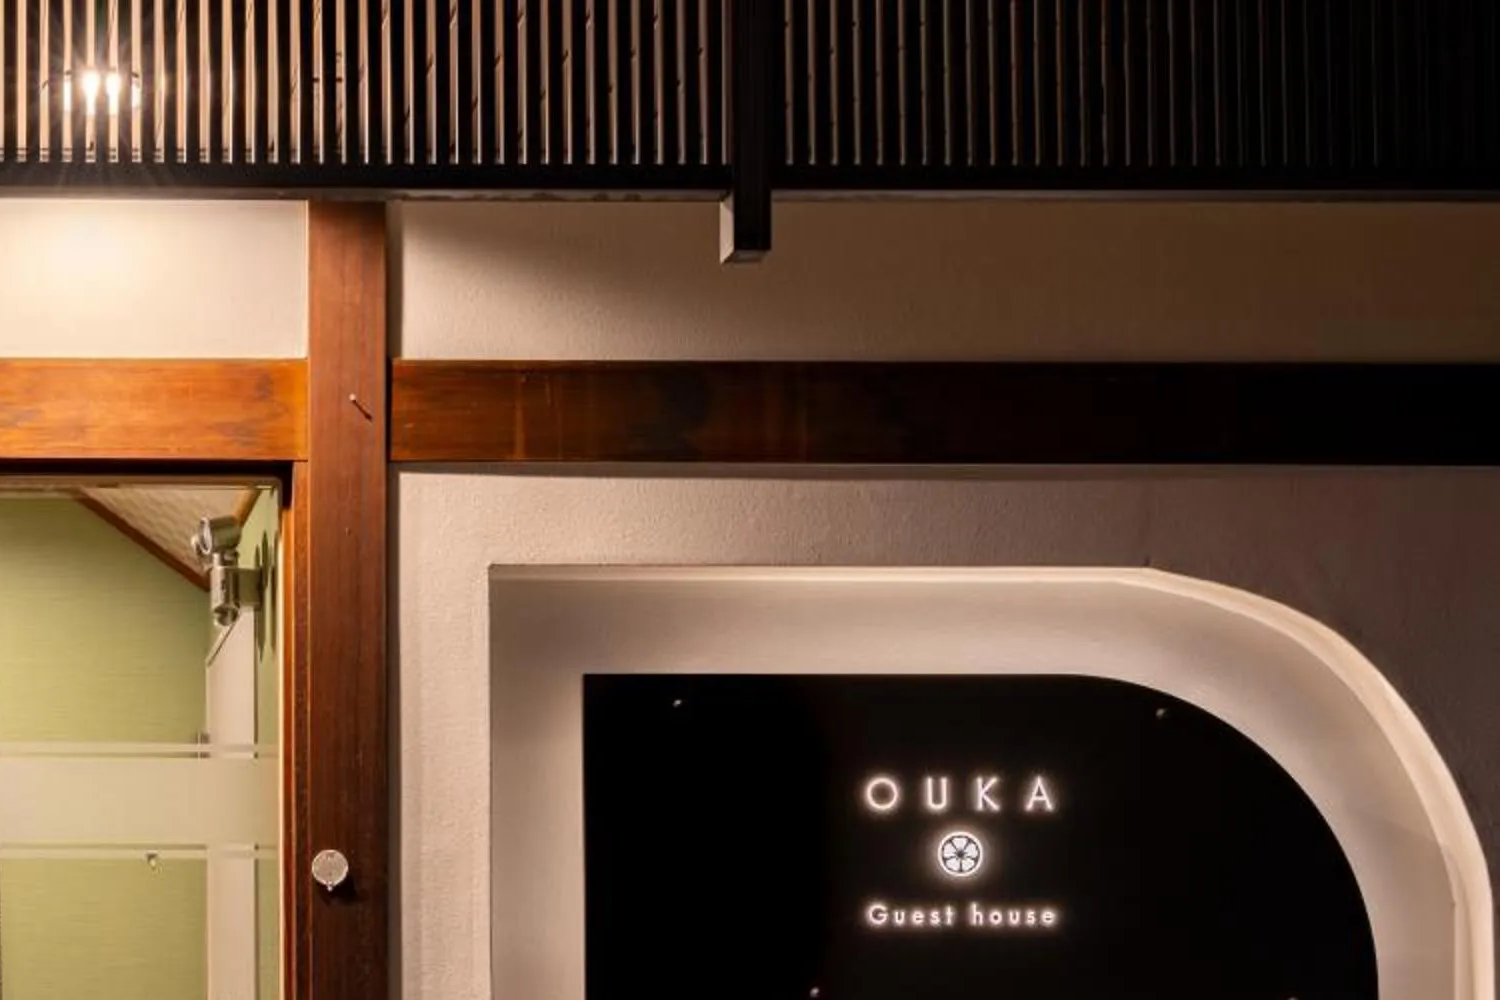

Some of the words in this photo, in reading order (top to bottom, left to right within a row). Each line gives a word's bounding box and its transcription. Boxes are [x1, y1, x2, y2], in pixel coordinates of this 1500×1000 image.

[864, 775, 1054, 812] OUKA
[866, 902, 955, 926] Guest
[969, 902, 1056, 926] house
